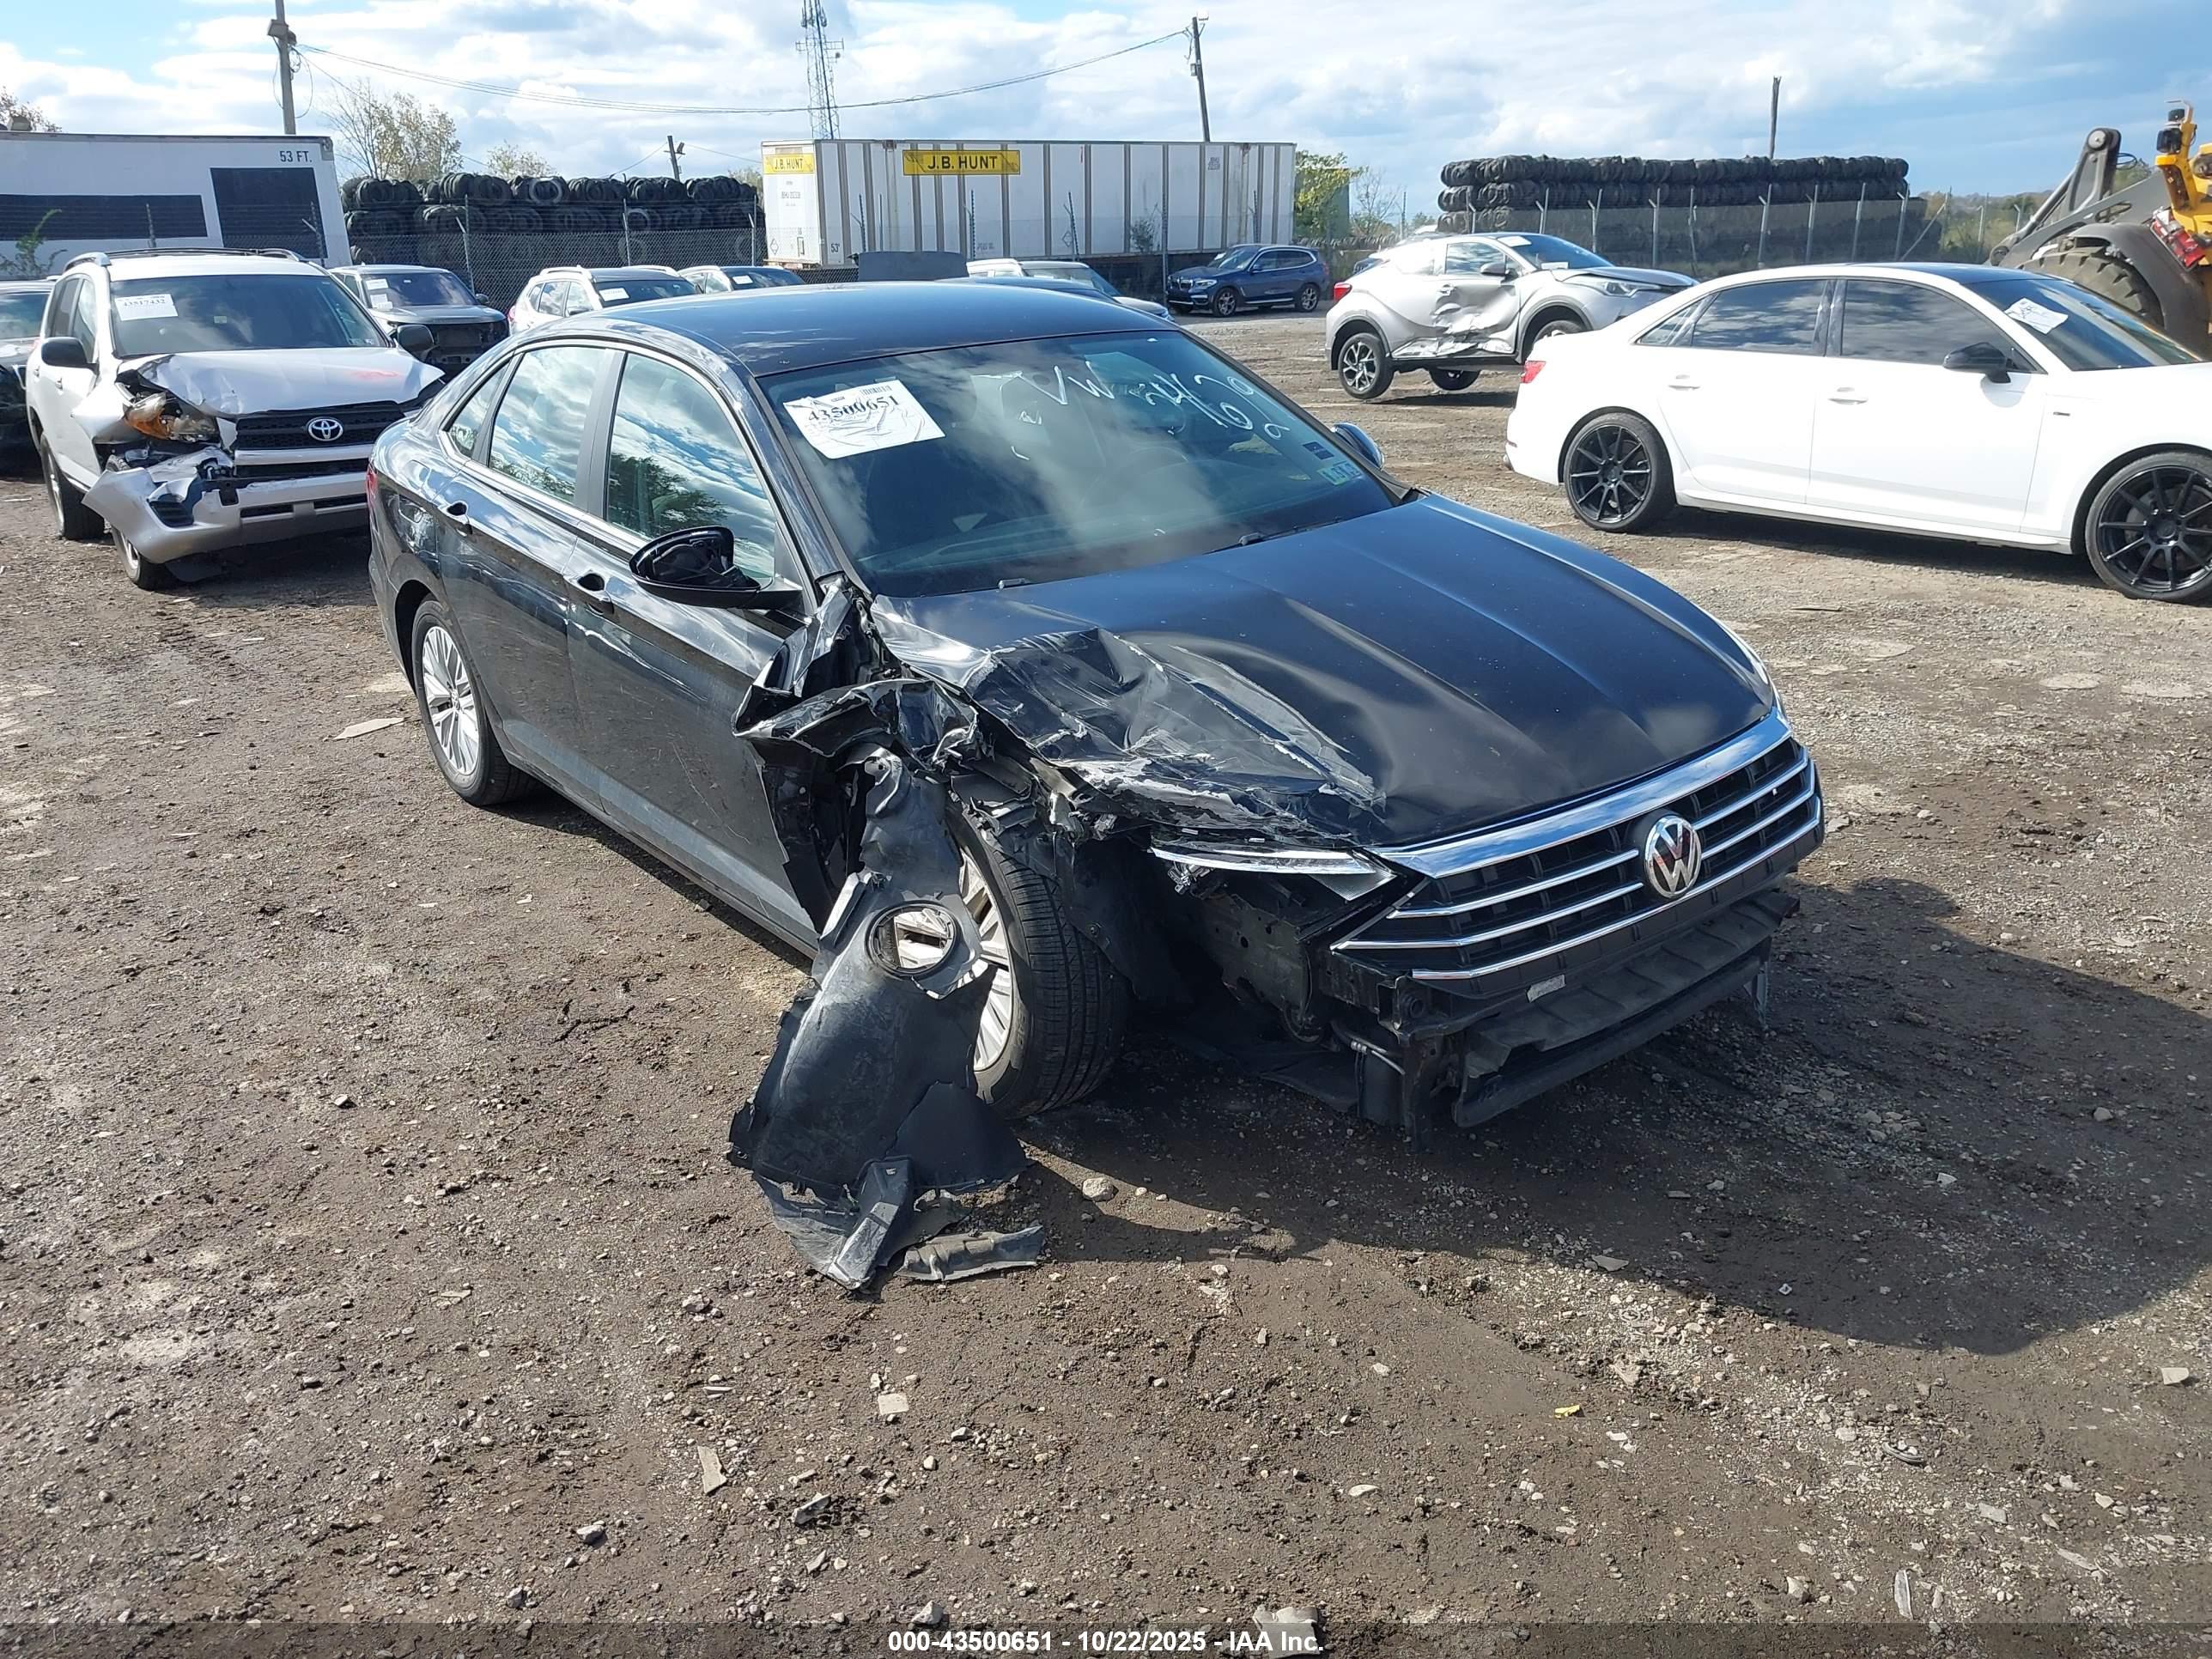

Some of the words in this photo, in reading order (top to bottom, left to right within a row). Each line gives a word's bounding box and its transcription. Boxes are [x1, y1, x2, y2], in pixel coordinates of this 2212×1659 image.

[279, 150, 294, 162] 53
[296, 150, 313, 162] FT.
[927, 155, 955, 170] J.B.
[958, 155, 998, 169] HUNT
[775, 159, 786, 170] J.B.
[786, 158, 804, 169] HUNT
[808, 394, 900, 422] 43500651
